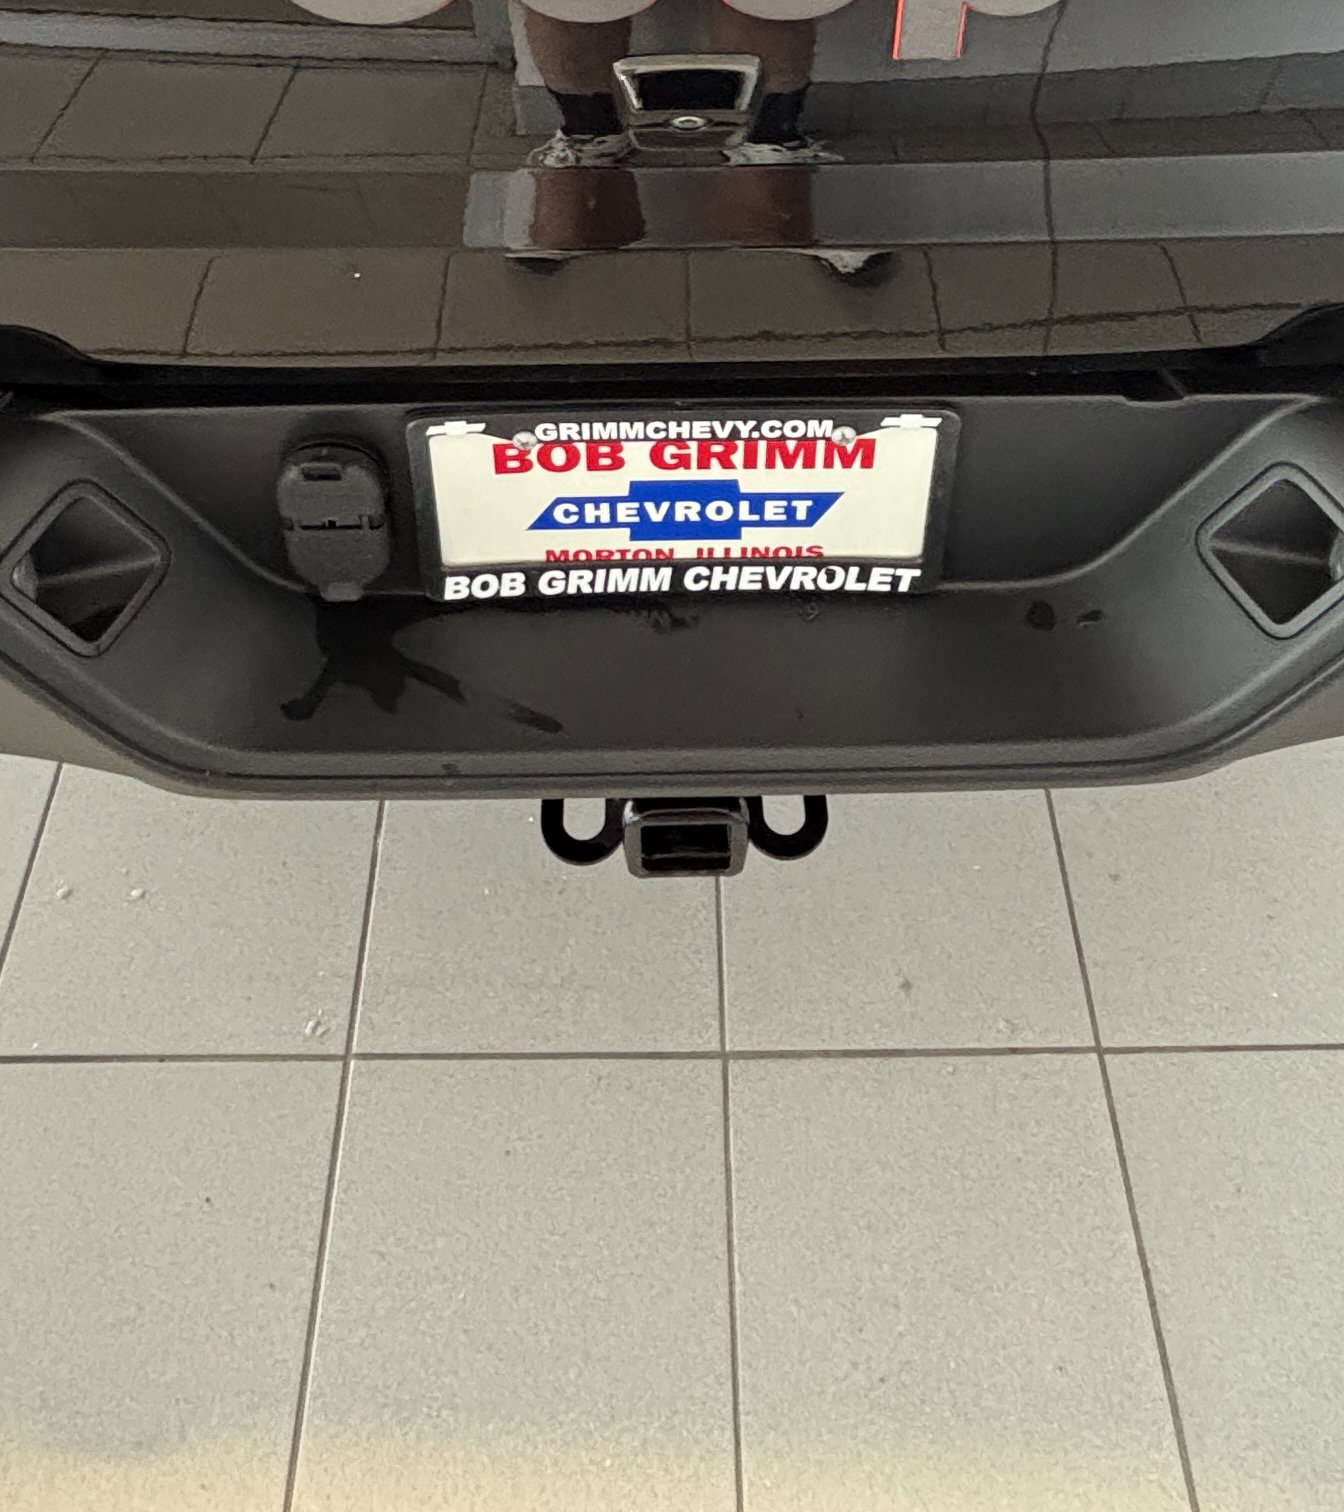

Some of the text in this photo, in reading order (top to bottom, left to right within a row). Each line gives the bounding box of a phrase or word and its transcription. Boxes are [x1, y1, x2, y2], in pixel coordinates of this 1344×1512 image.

[535, 420, 833, 441] GRIMMCHEVY.COM
[493, 438, 876, 475] BOB GRIMM
[553, 500, 813, 524] CHEVROLET
[545, 548, 674, 563] MORTON
[444, 565, 922, 600] BOB GRIMM CHEVROLET
